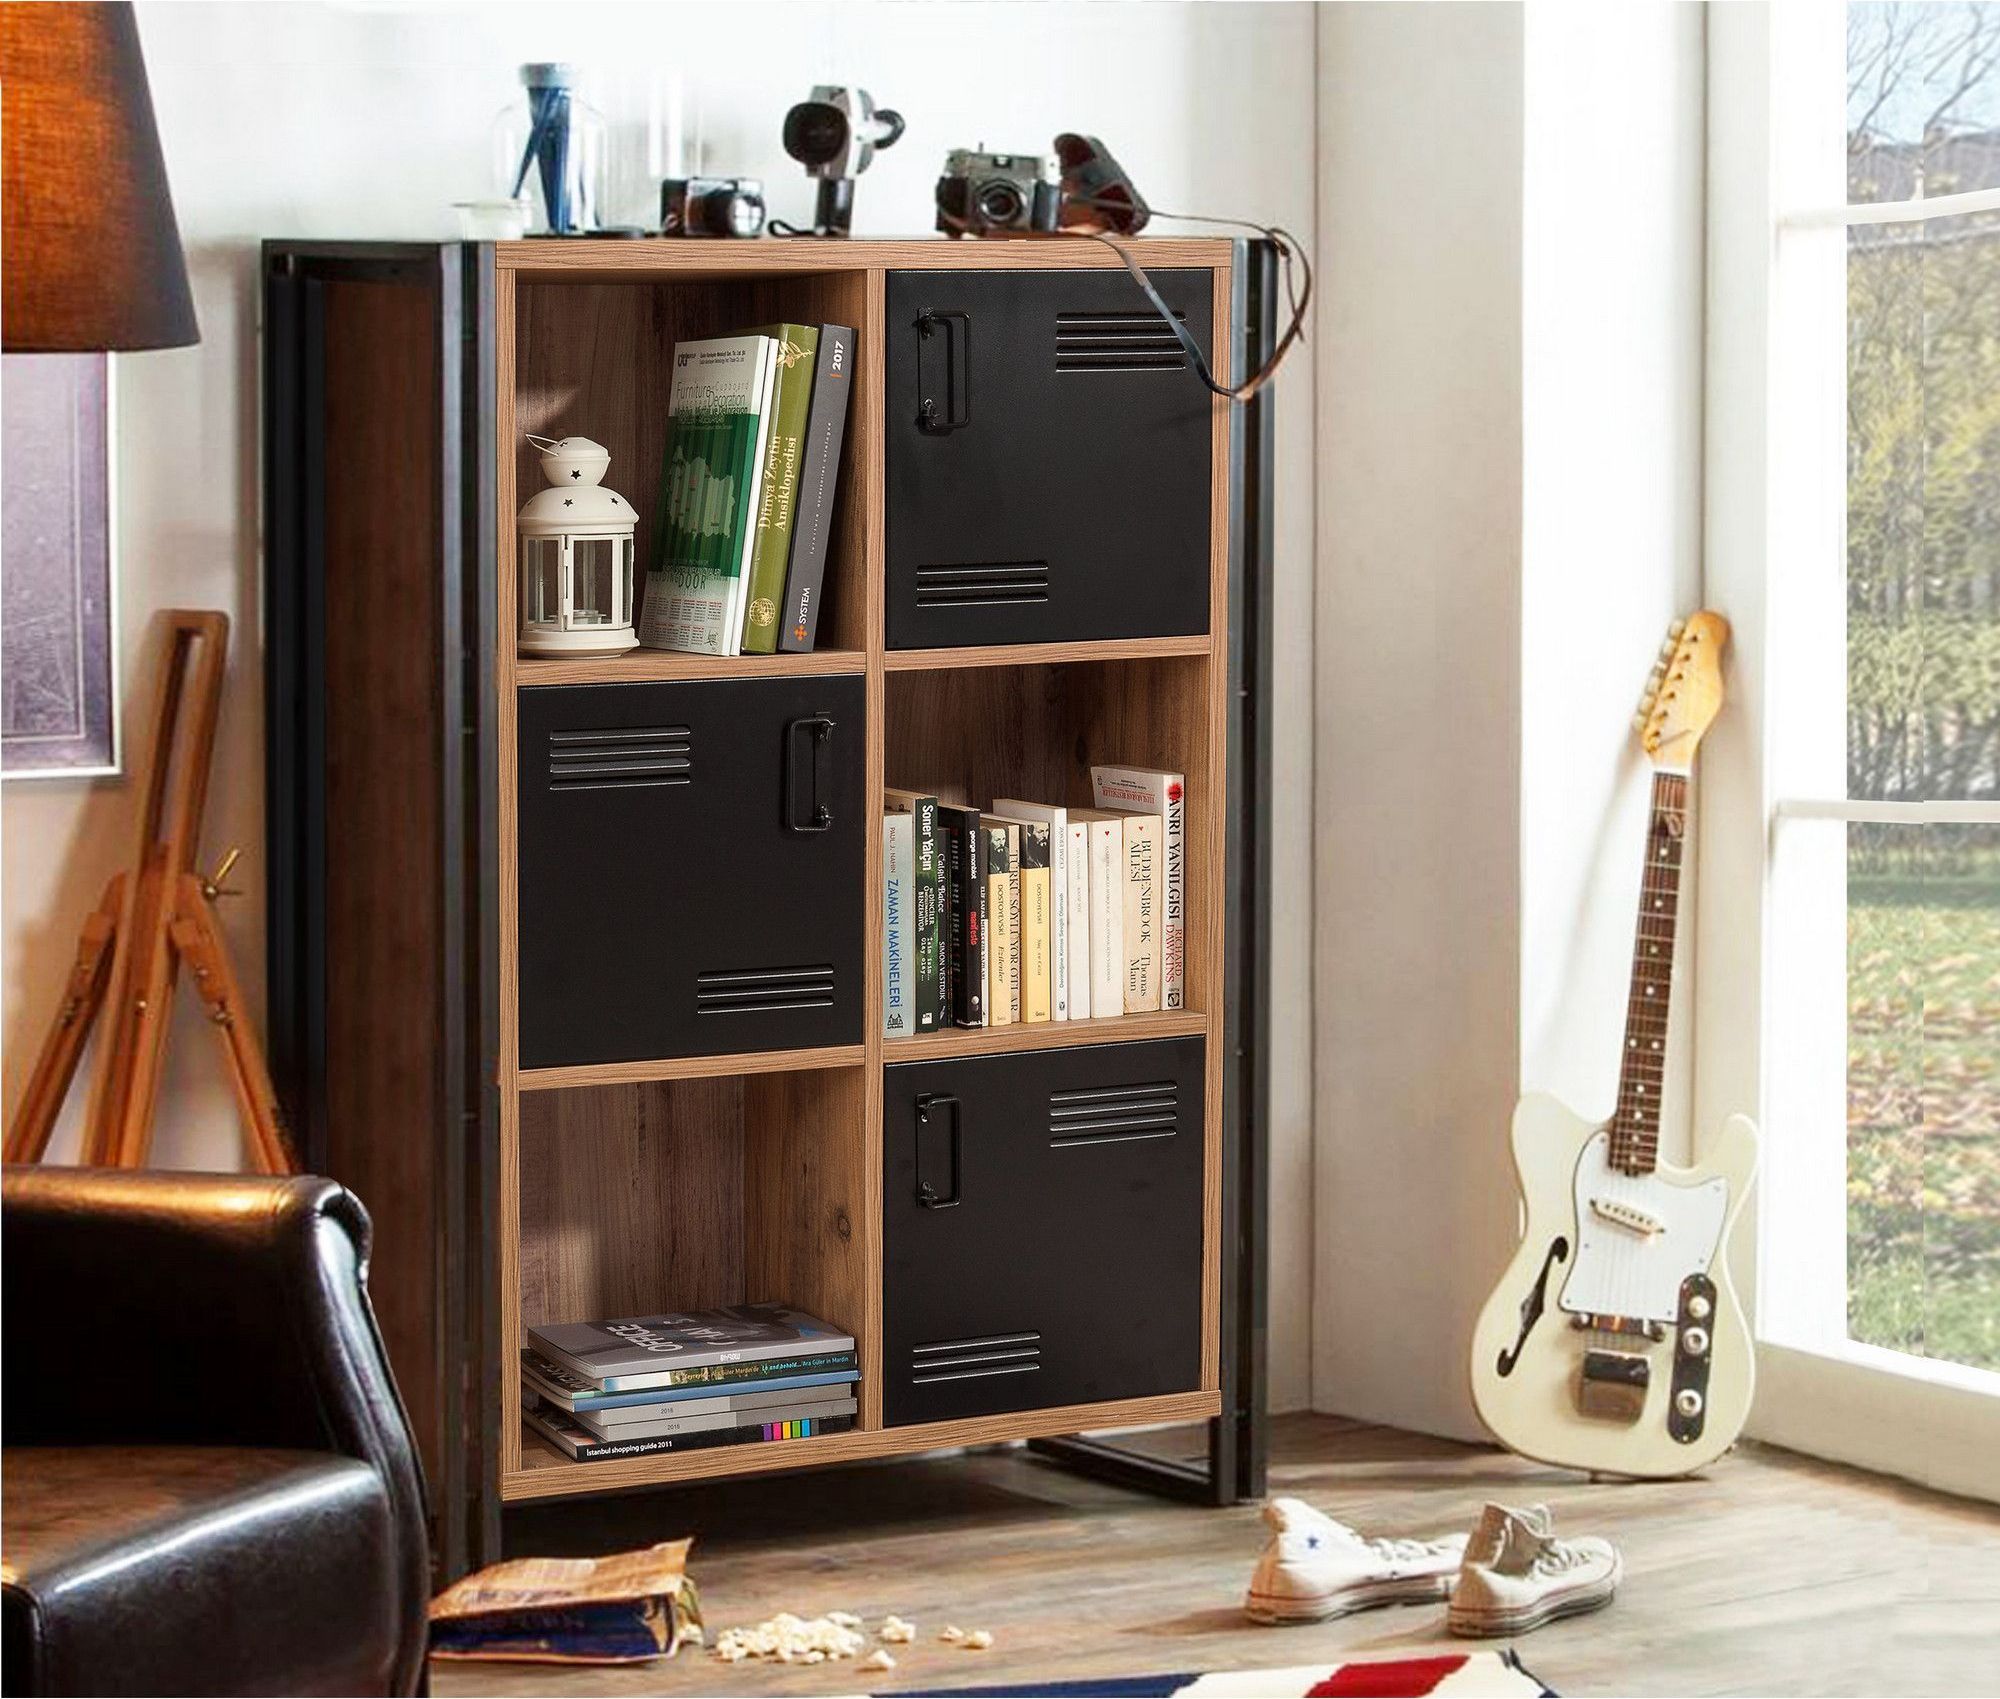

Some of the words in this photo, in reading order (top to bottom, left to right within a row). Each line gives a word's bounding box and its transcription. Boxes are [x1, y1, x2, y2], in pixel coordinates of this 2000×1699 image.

[832, 341, 844, 371] 2017
[677, 381, 711, 399] Furniture
[708, 391, 746, 407] Decoration
[764, 435, 782, 480] Zeytin
[774, 437, 797, 532] Ansiklopedisi
[799, 587, 811, 625] SYSTEM
[922, 804, 934, 838] Soner
[919, 839, 934, 871] Yalçın
[1141, 840, 1152, 943] BUDDENBROOK
[1168, 842, 1181, 920] YANILGISI
[888, 879, 899, 925] ZAMAN
[970, 911, 978, 945] manifesto
[888, 930, 903, 1008] MAKİNELERİ
[1166, 924, 1175, 983] DAWKINS
[1174, 928, 1183, 977] RICHARD
[1129, 959, 1140, 992] Mann
[1140, 953, 1151, 997] Thomas
[606, 1323, 683, 1352] OFFICE
[611, 1444, 640, 1454] shopping
[640, 1441, 657, 1451] guide
